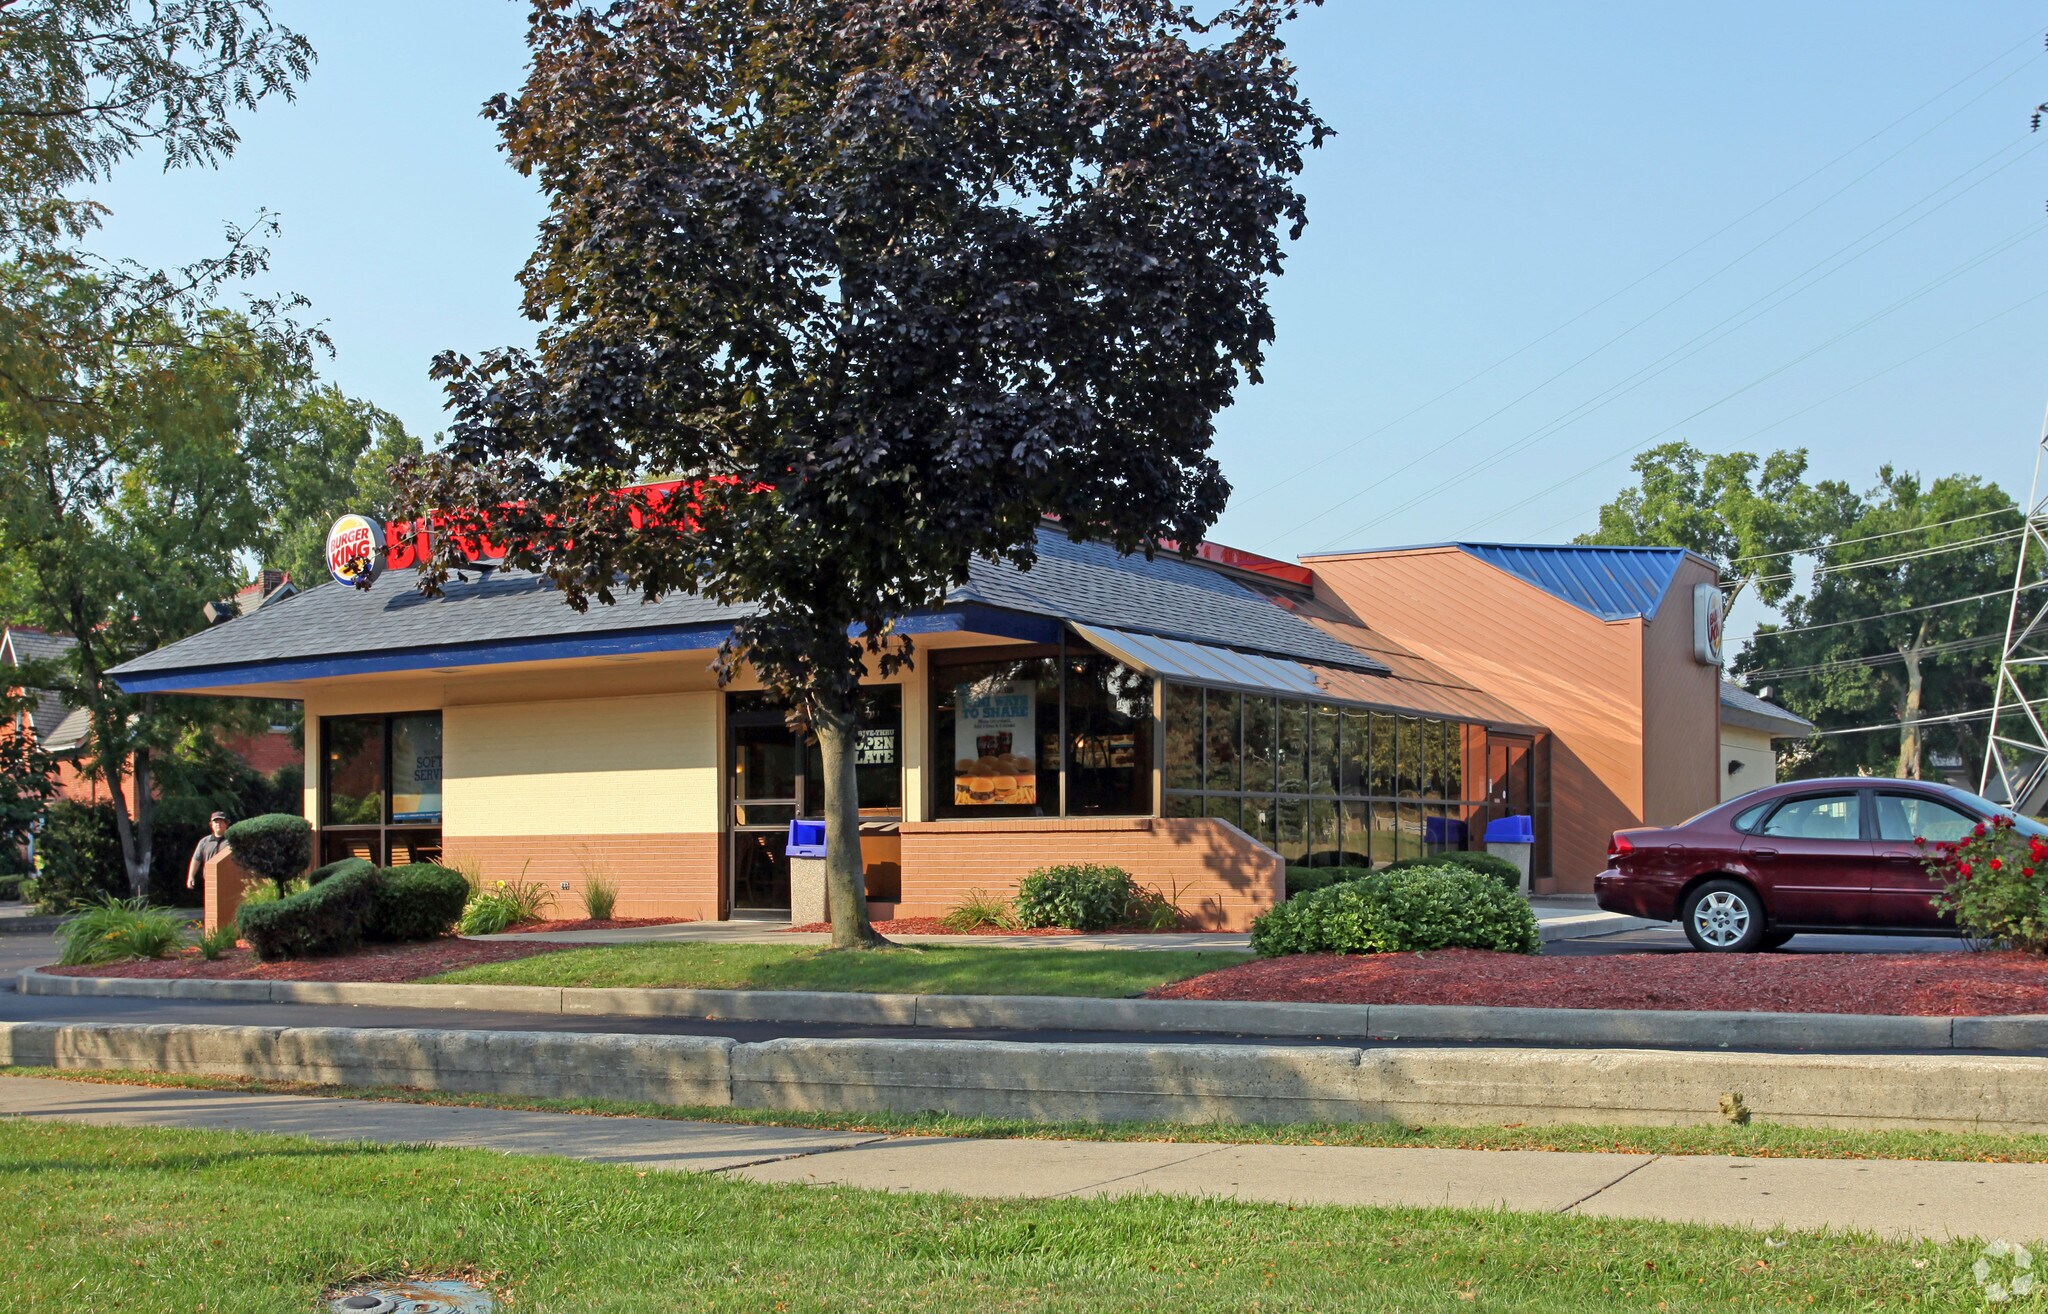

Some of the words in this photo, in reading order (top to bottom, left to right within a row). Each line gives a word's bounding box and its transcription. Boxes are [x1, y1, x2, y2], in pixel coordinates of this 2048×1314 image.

[331, 528, 369, 553] BURGER
[332, 540, 370, 571] KING
[963, 708, 979, 718] TO
[983, 706, 1028, 718] SHARE
[857, 729, 894, 737] RIVE-THRU
[855, 736, 894, 750] OPEN
[416, 756, 442, 768] SOFT
[855, 749, 894, 764] LATE
[414, 769, 442, 781] SERV
